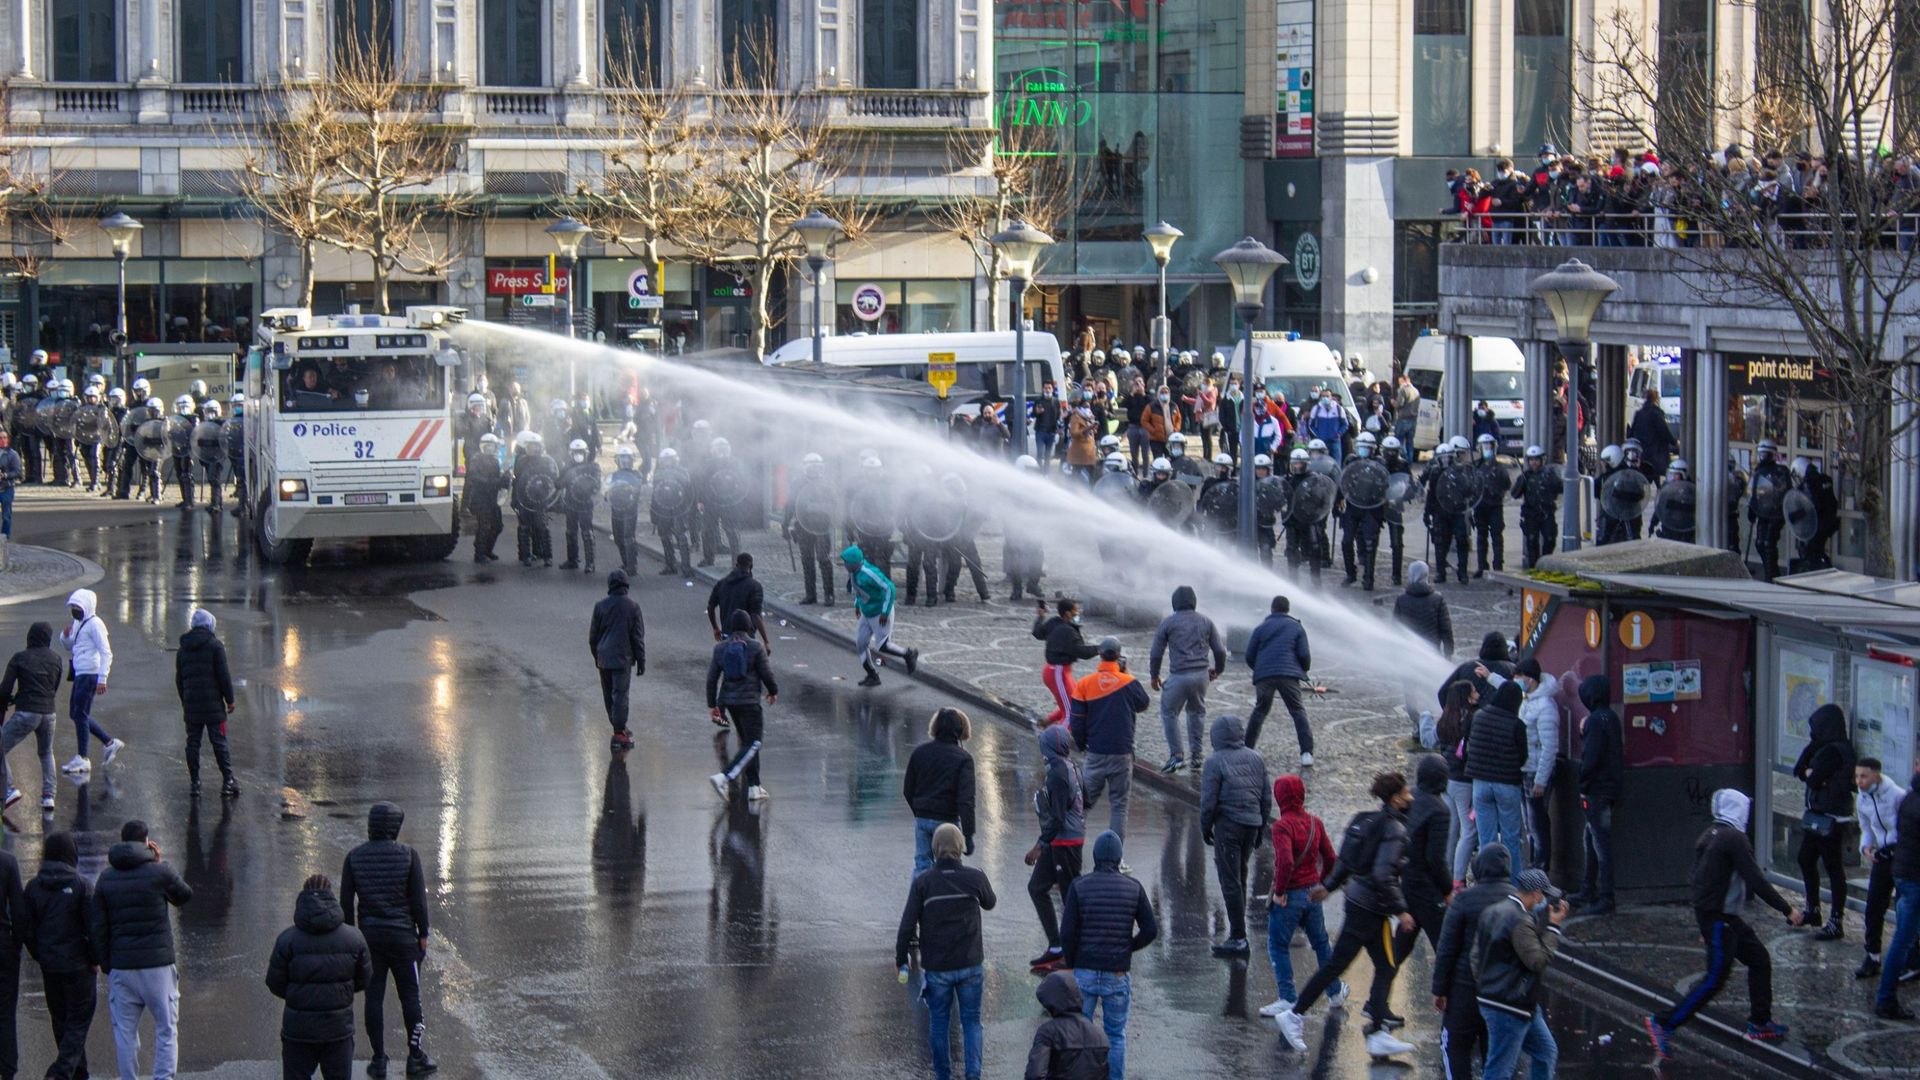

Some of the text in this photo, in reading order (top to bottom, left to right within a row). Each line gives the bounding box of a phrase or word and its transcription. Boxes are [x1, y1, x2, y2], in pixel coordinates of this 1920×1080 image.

[1301, 252, 1314, 270] BT
[494, 272, 568, 292] Press Sop
[1748, 356, 1814, 385] point chaud
[312, 423, 357, 437] Police
[353, 440, 375, 459] 32
